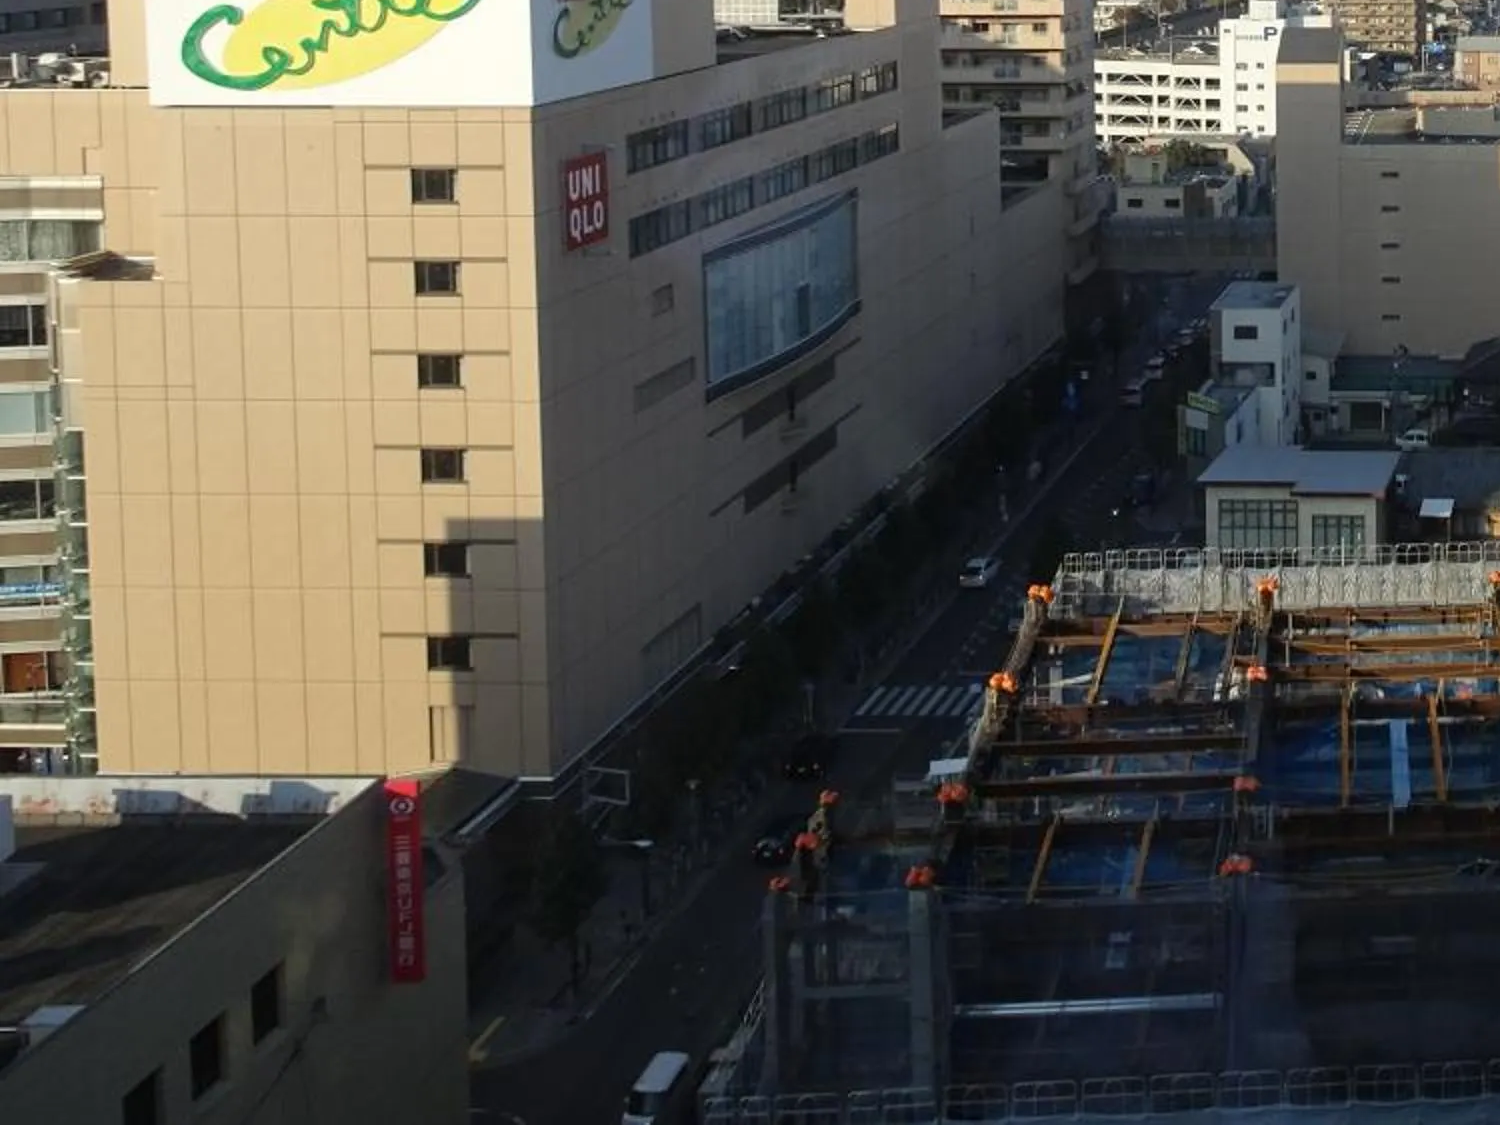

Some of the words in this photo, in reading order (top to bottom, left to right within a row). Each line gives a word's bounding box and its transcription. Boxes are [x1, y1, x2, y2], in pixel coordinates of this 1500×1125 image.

[1263, 26, 1278, 42] P
[569, 162, 601, 202] UNI
[570, 200, 605, 243] QLO
